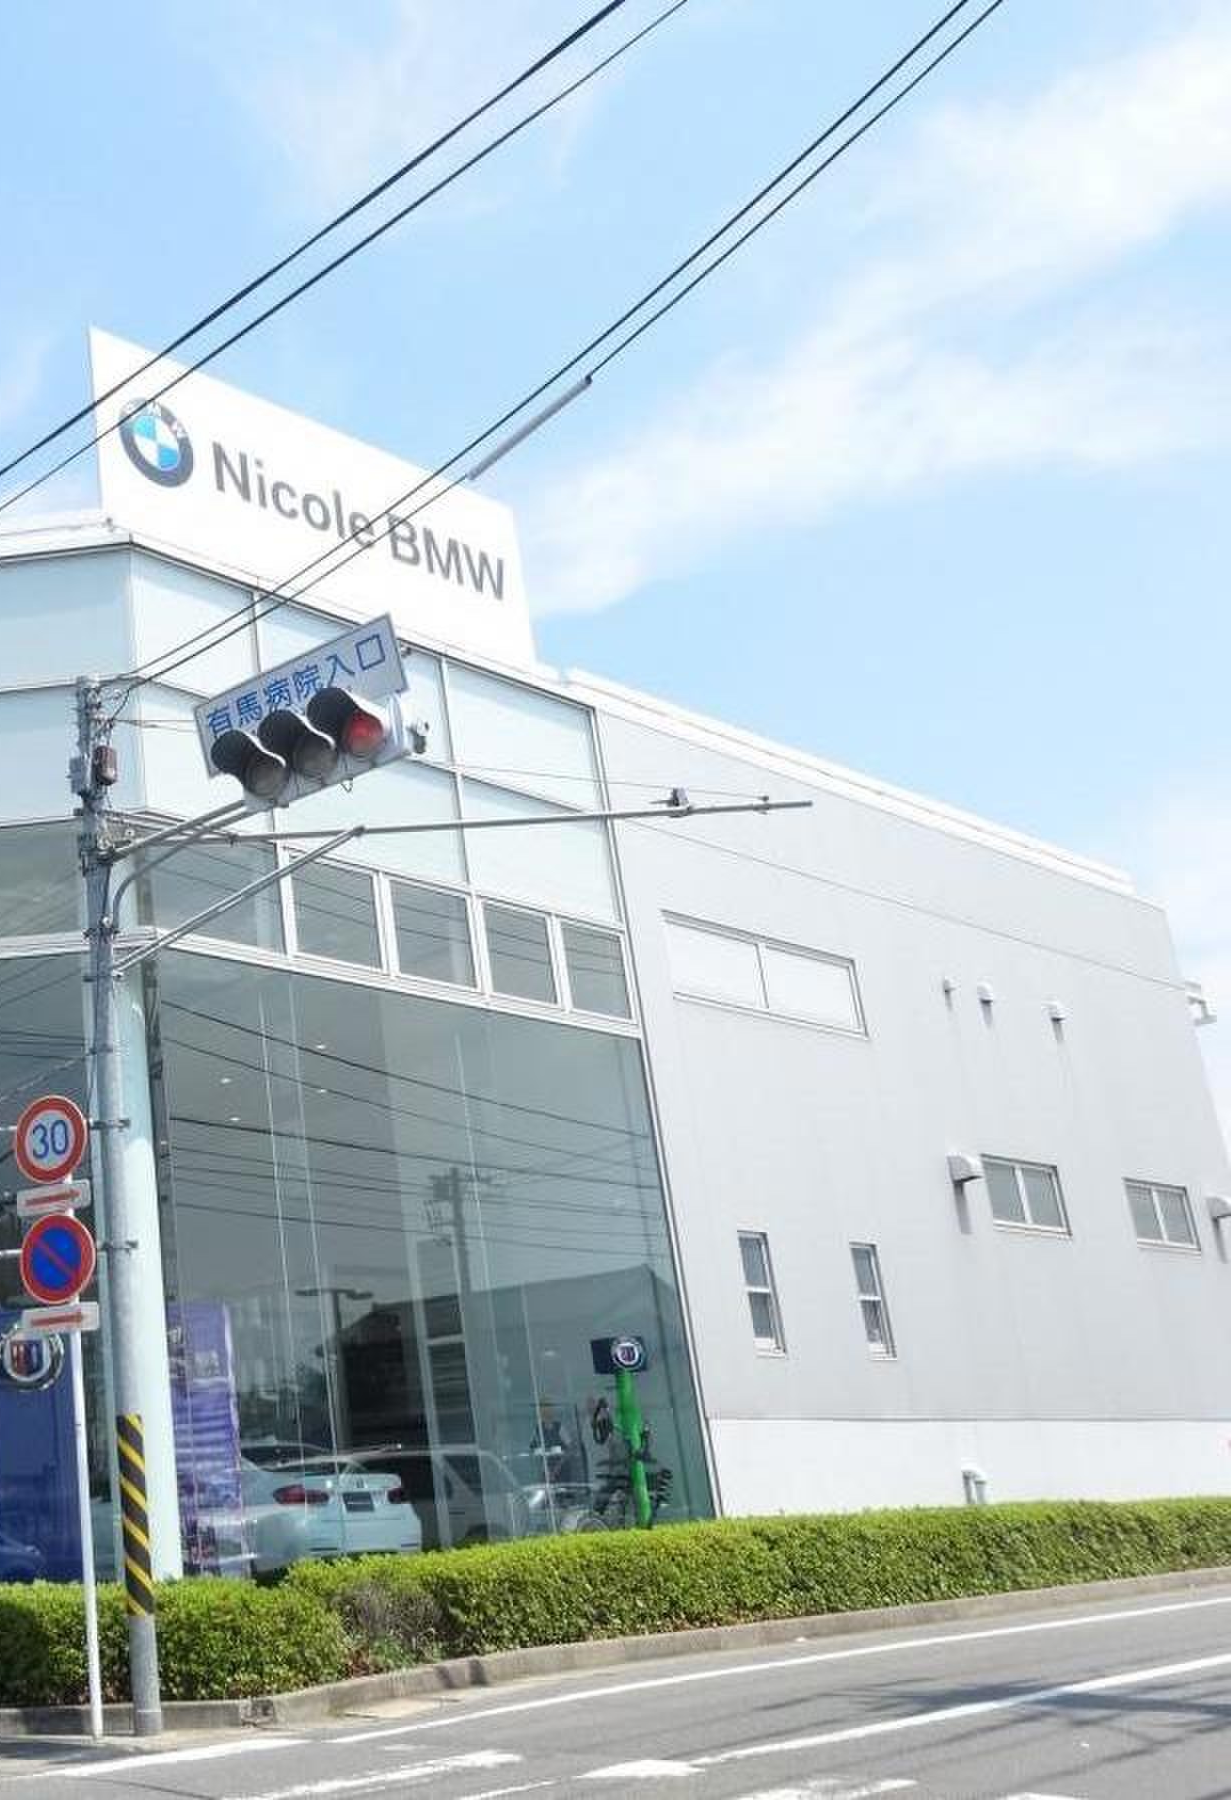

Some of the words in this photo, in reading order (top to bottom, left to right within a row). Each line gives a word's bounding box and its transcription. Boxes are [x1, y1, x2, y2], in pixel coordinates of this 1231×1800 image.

[212, 441, 375, 549] Nicole
[386, 511, 505, 602] BMW
[207, 634, 386, 738] 有馬病院入口
[32, 1119, 69, 1159] 30
